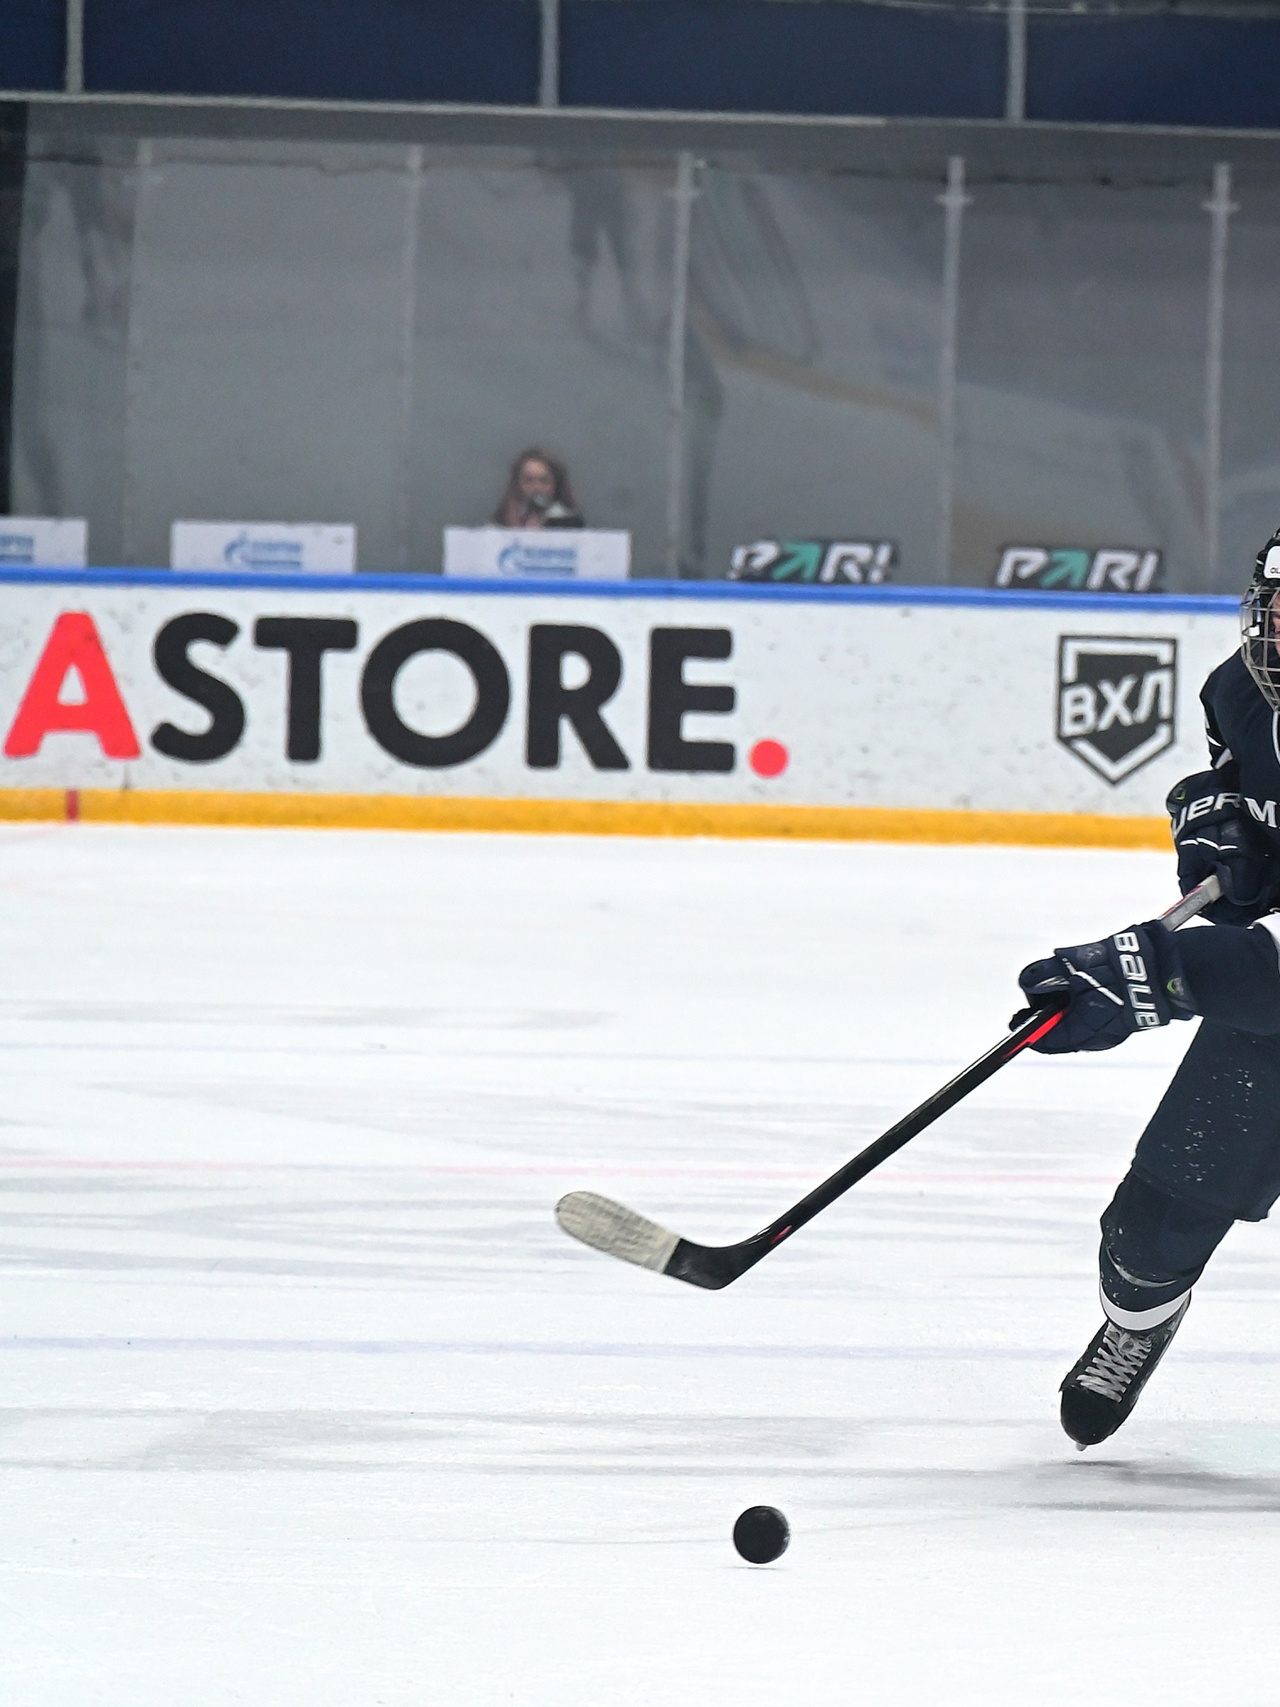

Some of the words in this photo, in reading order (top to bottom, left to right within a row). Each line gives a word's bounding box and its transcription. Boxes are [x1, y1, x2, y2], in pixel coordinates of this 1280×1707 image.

[4, 611, 790, 778] ASTORE.
[1060, 666, 1174, 738] ВХЛ
[1173, 793, 1242, 840] UER
[1113, 931, 1162, 1030] BAUE
